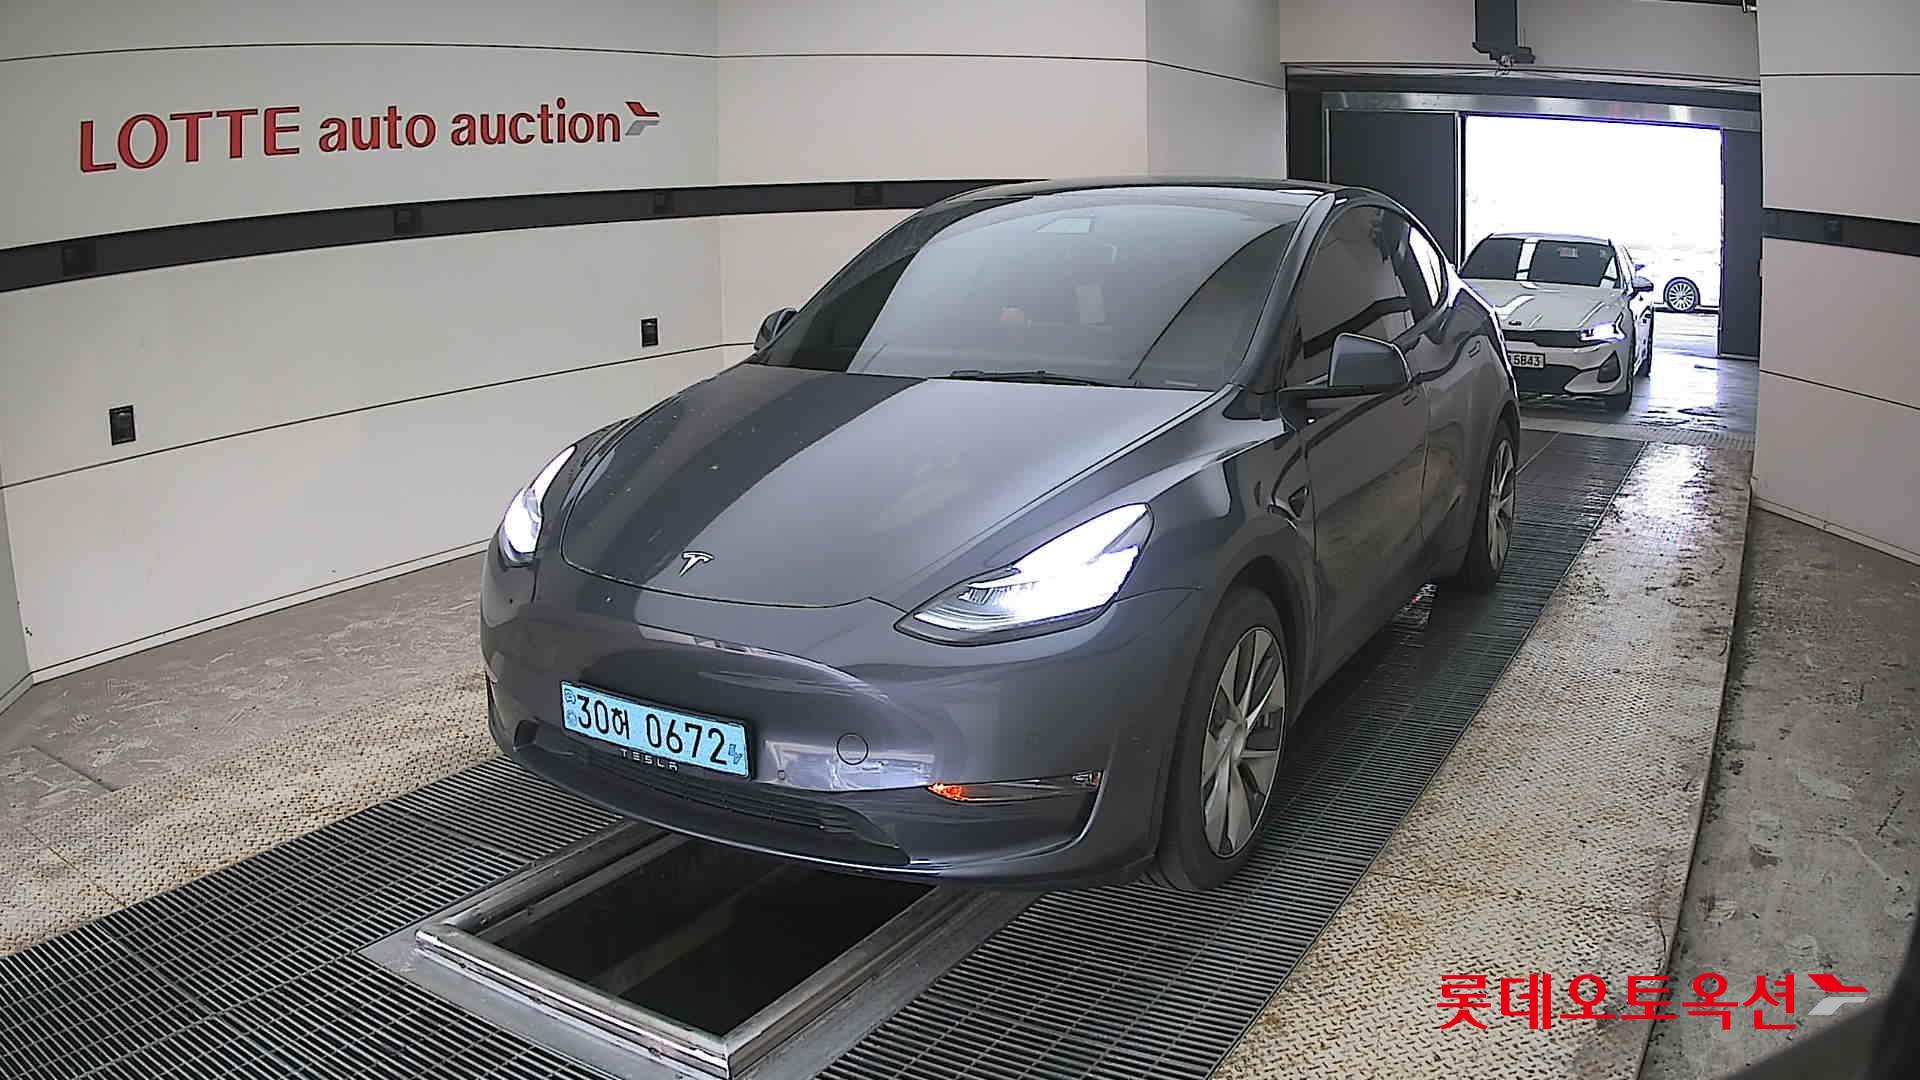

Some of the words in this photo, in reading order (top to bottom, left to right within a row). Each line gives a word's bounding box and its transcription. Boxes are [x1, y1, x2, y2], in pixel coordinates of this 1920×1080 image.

[80, 106, 300, 173] LOTTE
[318, 105, 437, 153] auto
[450, 97, 622, 146] auction
[1513, 355, 1541, 367] 5843
[577, 694, 630, 740] 30허
[646, 713, 728, 766] 0672
[619, 748, 679, 771] TESLA
